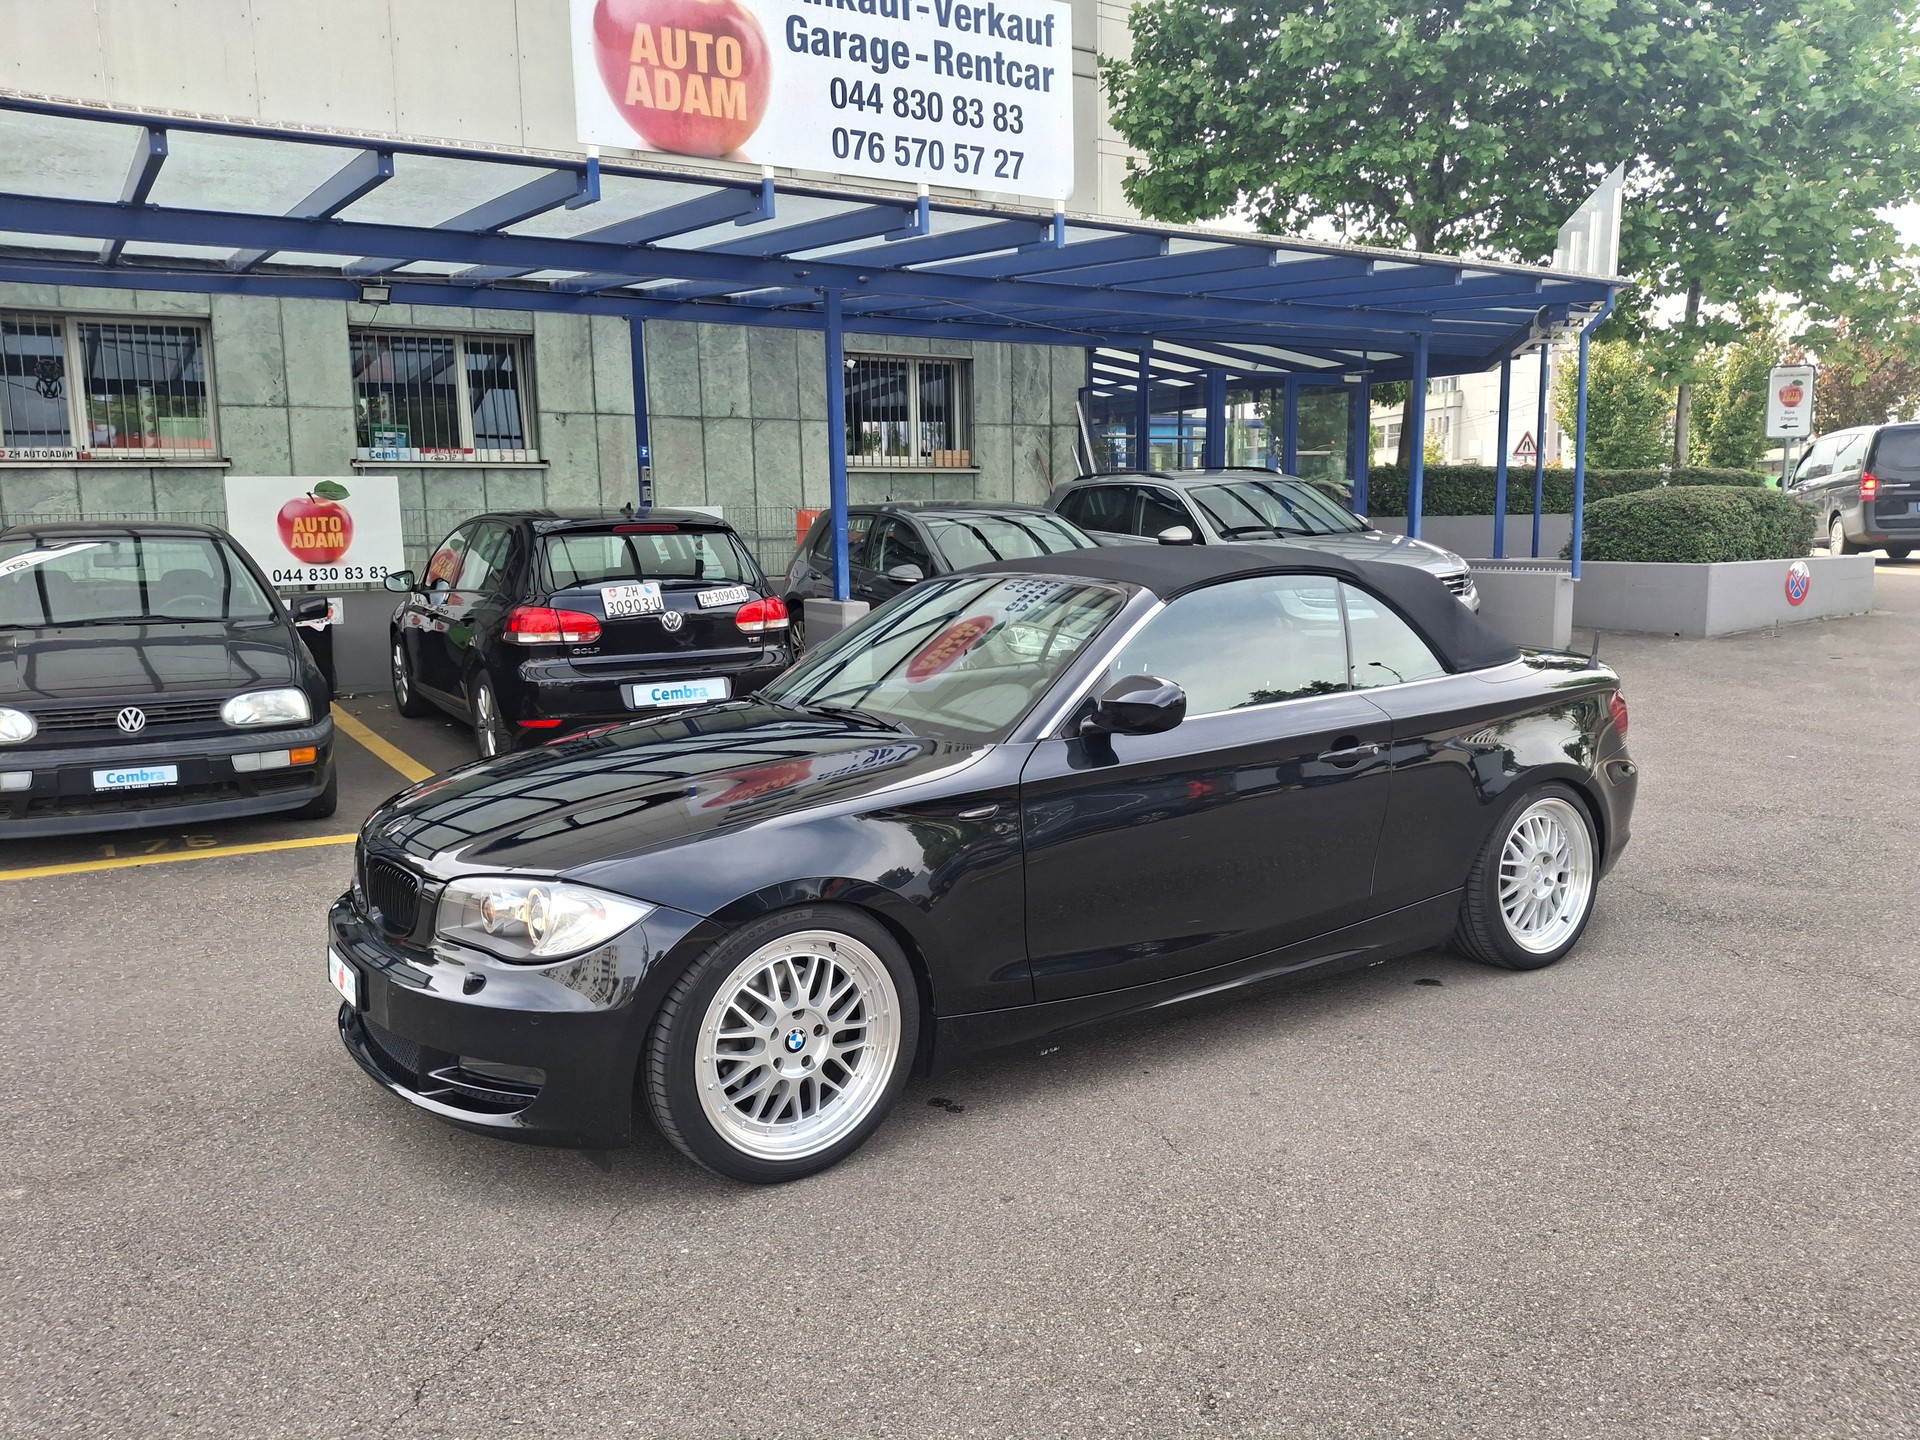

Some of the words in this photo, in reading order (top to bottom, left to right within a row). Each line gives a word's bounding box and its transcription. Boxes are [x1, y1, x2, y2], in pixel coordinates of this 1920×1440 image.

[791, 0, 1054, 47] auf-Verkauf
[629, 22, 742, 78] AUTO
[624, 64, 747, 121] ADAM
[830, 77, 884, 114] 044
[893, 86, 943, 123] 830
[952, 95, 984, 128] 83
[993, 102, 1024, 134] 83
[832, 127, 885, 163] 076
[895, 135, 944, 171] 570
[954, 143, 985, 175] 57
[994, 148, 1024, 180] 27
[8, 450, 20, 458] ZH
[24, 450, 48, 458] AUTO
[49, 450, 74, 458] ADAM
[368, 450, 409, 460] Cembra
[292, 516, 342, 533] AUTO
[290, 532, 345, 549] ADAM
[272, 568, 303, 583] 044
[309, 567, 339, 581] 830
[344, 566, 364, 580] 83
[369, 565, 388, 579] 83
[624, 586, 639, 598] ZH
[572, 647, 601, 655] GOLF
[651, 685, 709, 701] Cembra
[106, 770, 166, 784] Cembra
